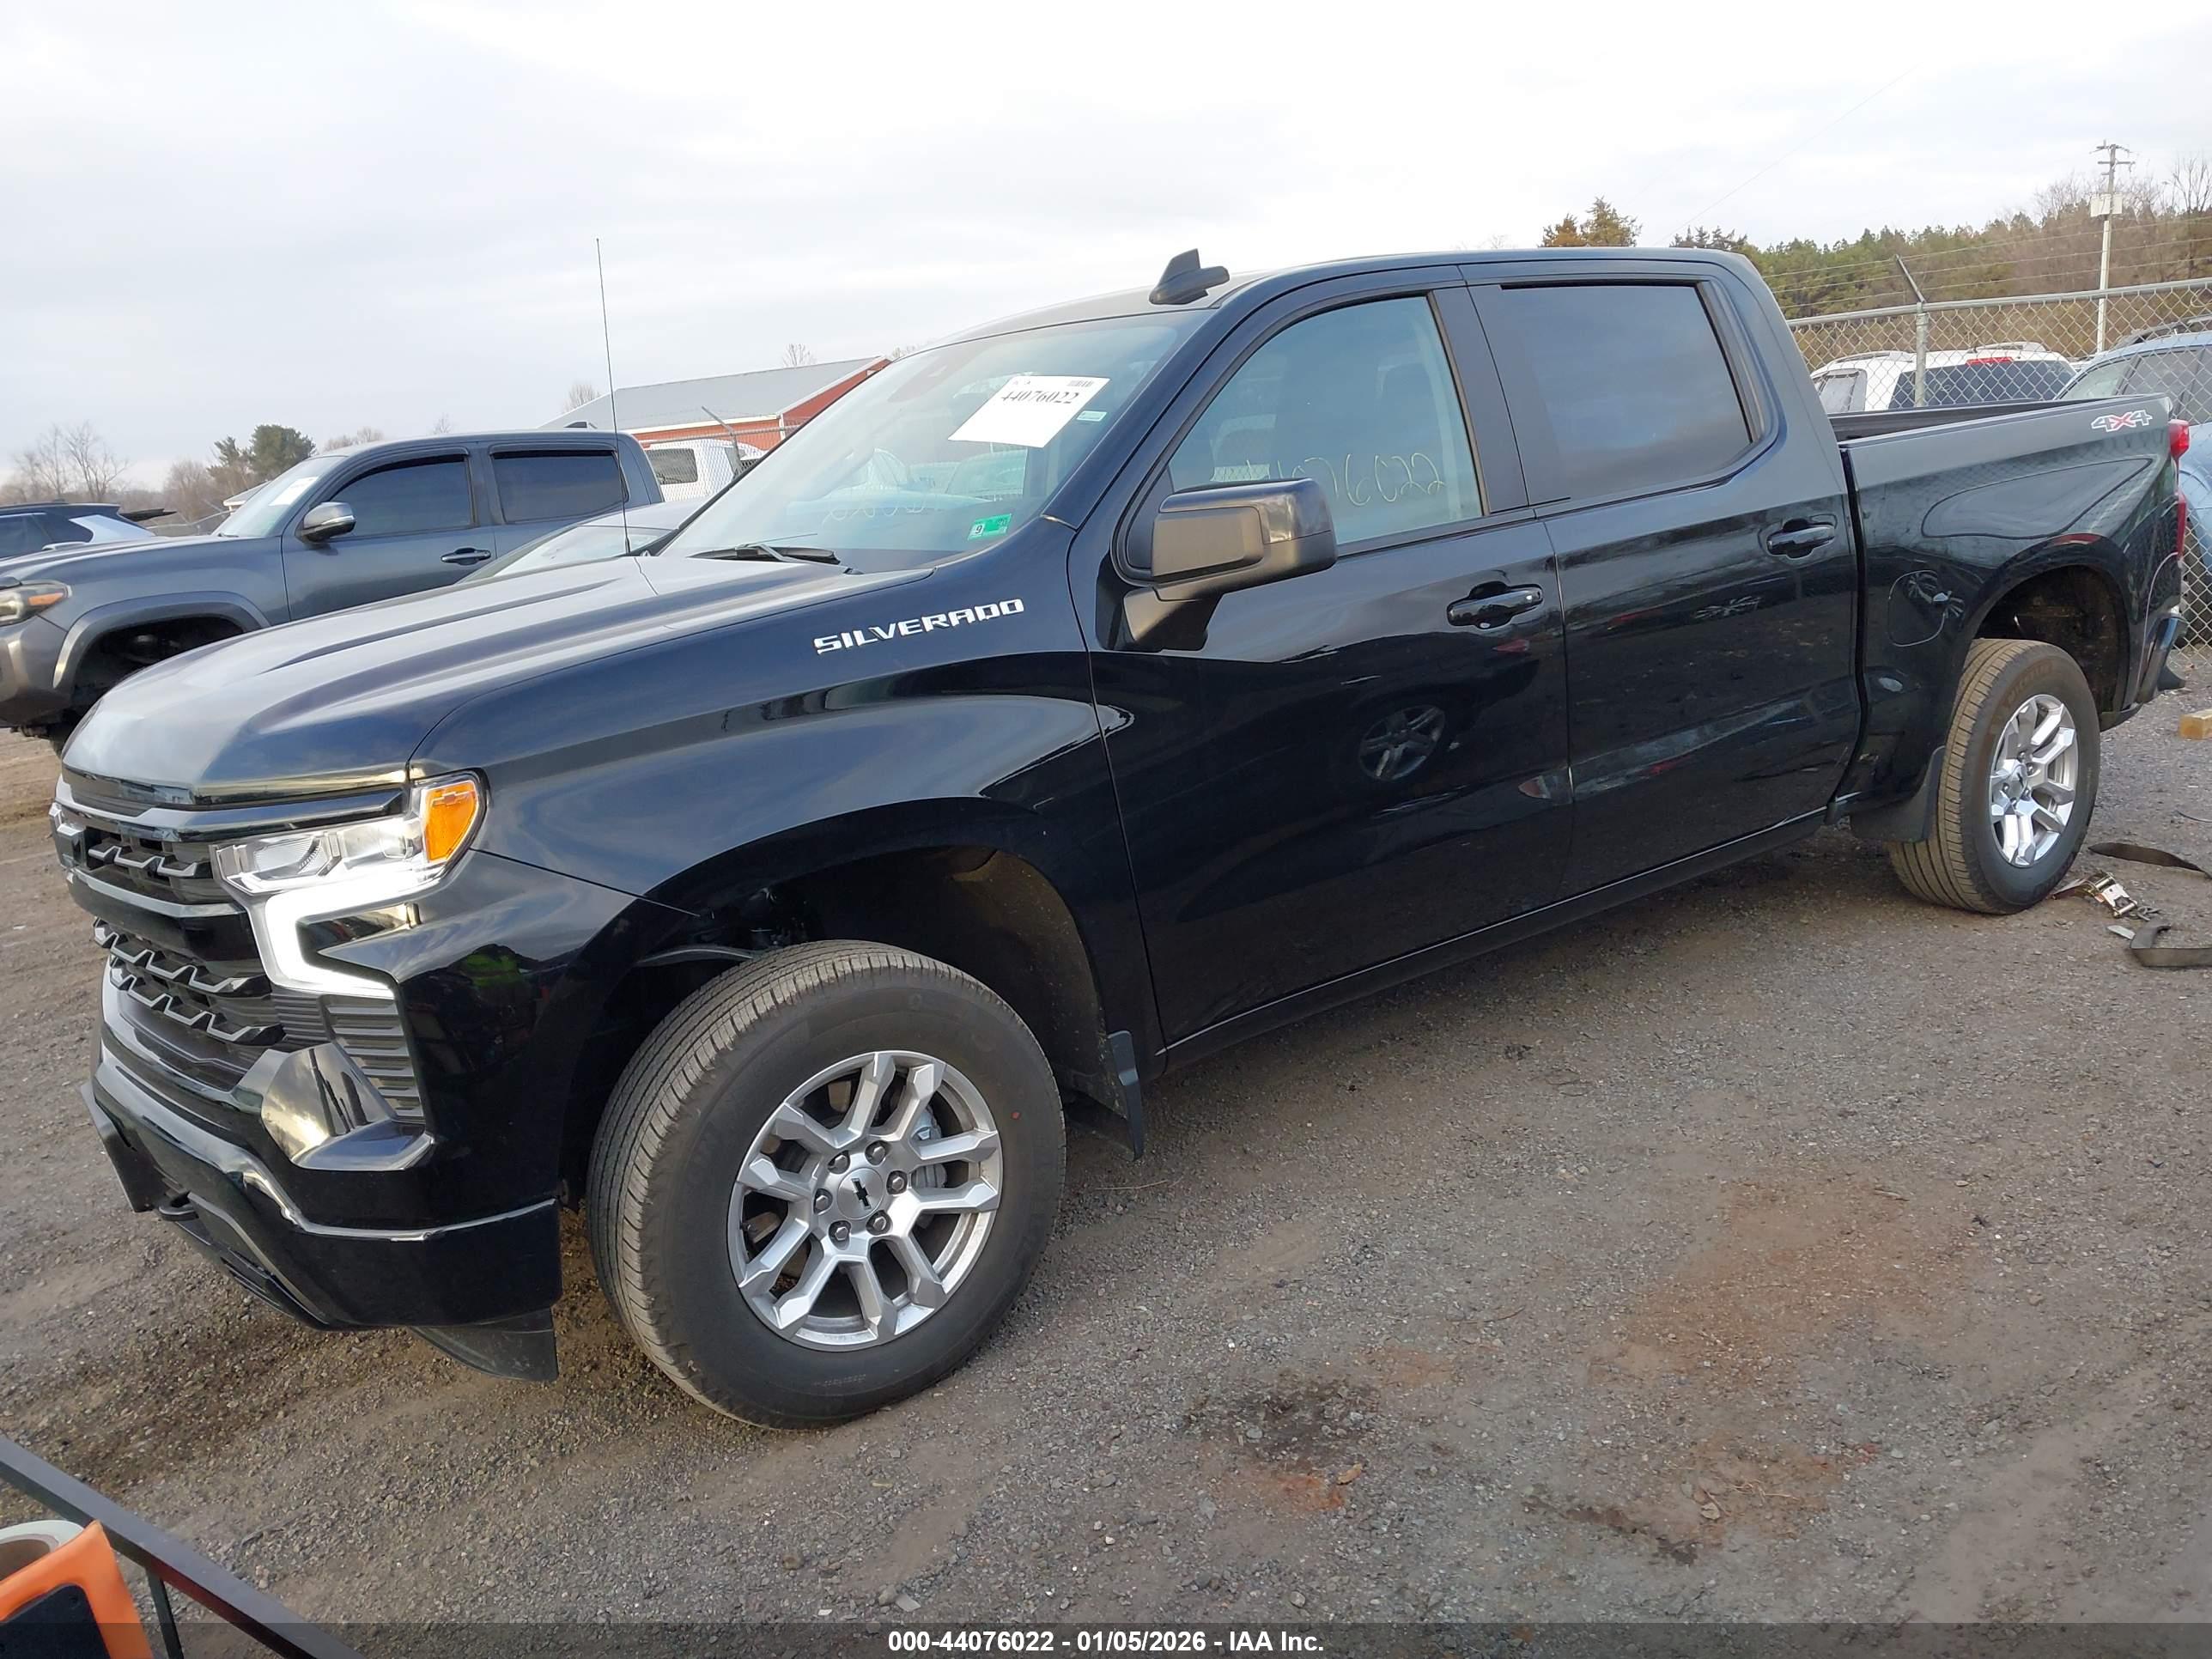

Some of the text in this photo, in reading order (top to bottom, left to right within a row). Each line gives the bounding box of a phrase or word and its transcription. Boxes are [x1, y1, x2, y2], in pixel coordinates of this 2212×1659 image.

[1001, 390, 1079, 404] 44076022
[975, 525, 983, 534] 9
[813, 598, 1024, 654] SILVERADO
